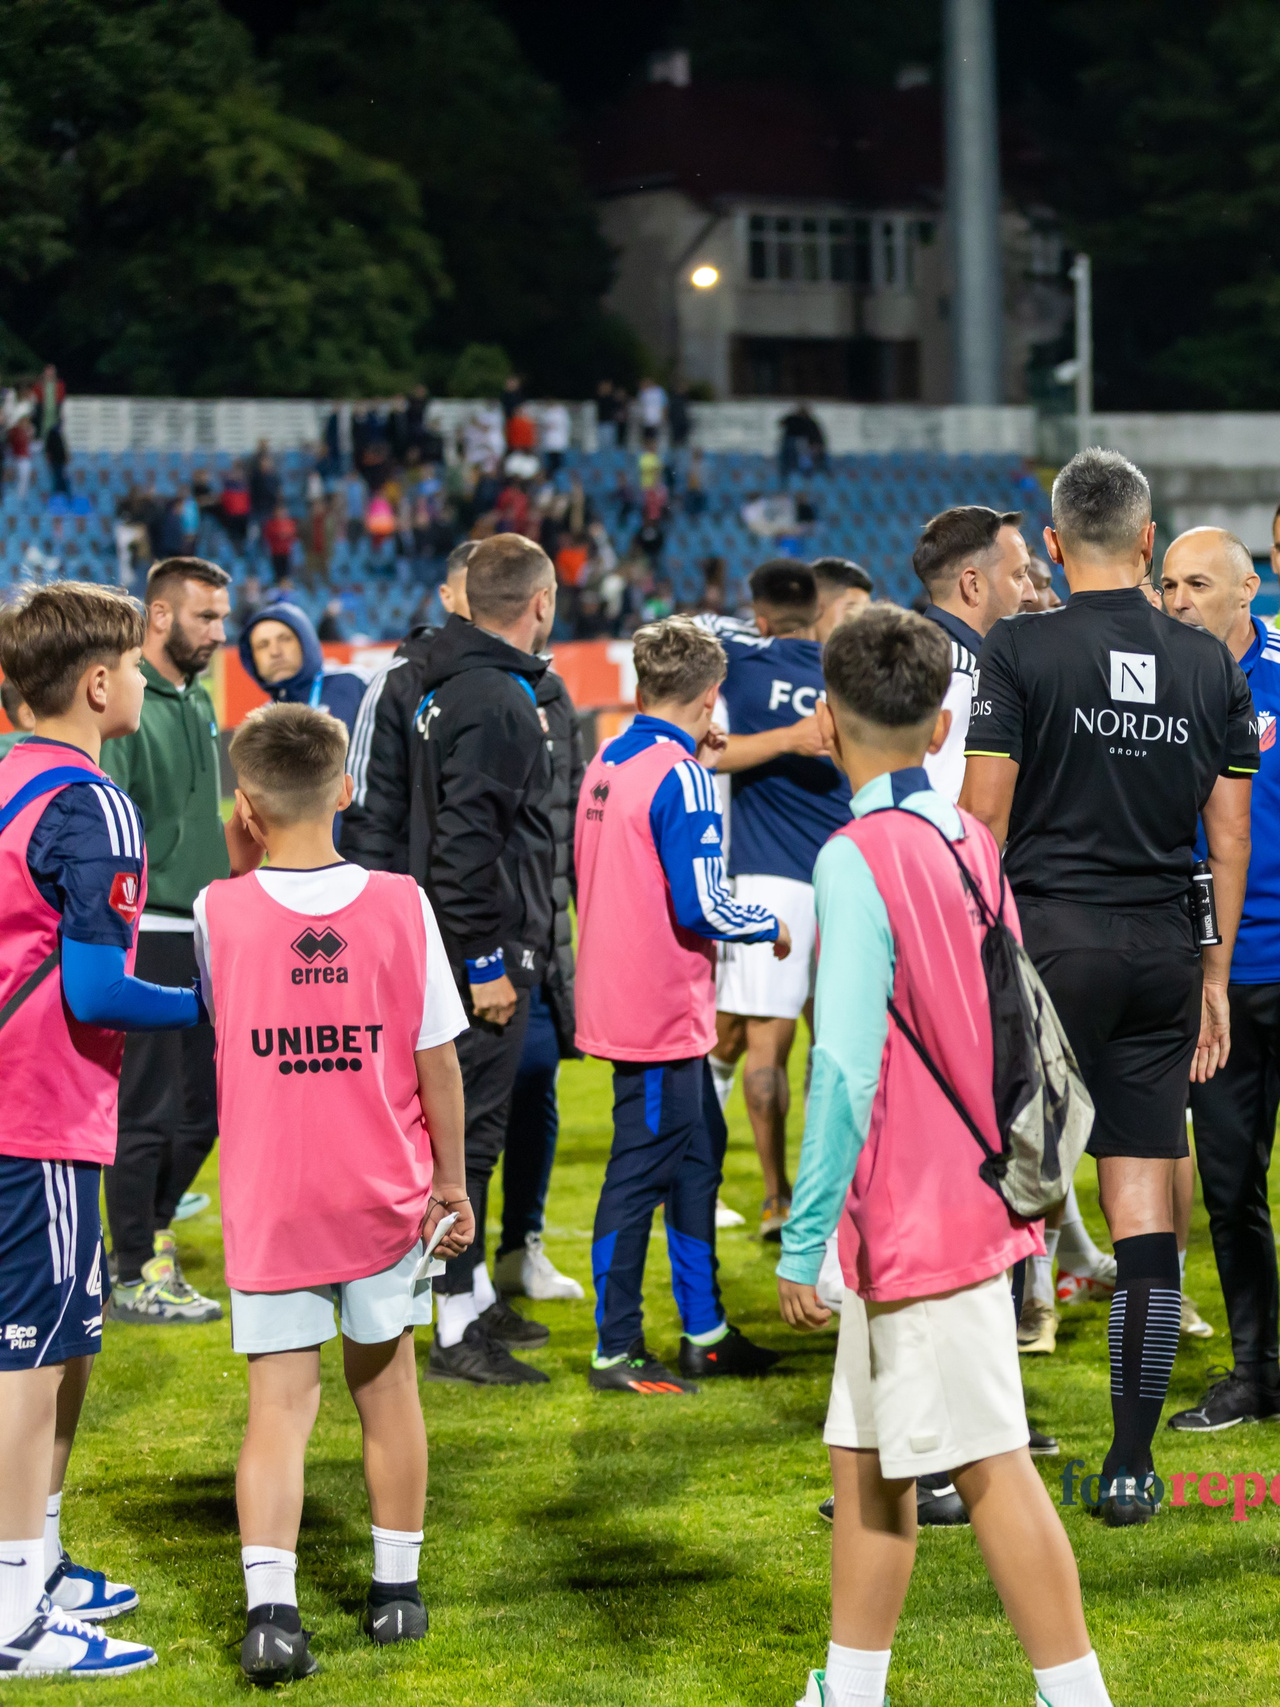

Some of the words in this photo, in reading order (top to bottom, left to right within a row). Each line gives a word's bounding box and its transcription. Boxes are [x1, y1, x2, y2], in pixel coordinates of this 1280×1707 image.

[1073, 707, 1189, 744] NORDIS
[1109, 747, 1148, 757] GROUP
[291, 966, 348, 985] errea
[251, 1024, 383, 1057] UNIBET
[5, 1324, 37, 1340] Eco
[11, 1338, 37, 1350] Plus
